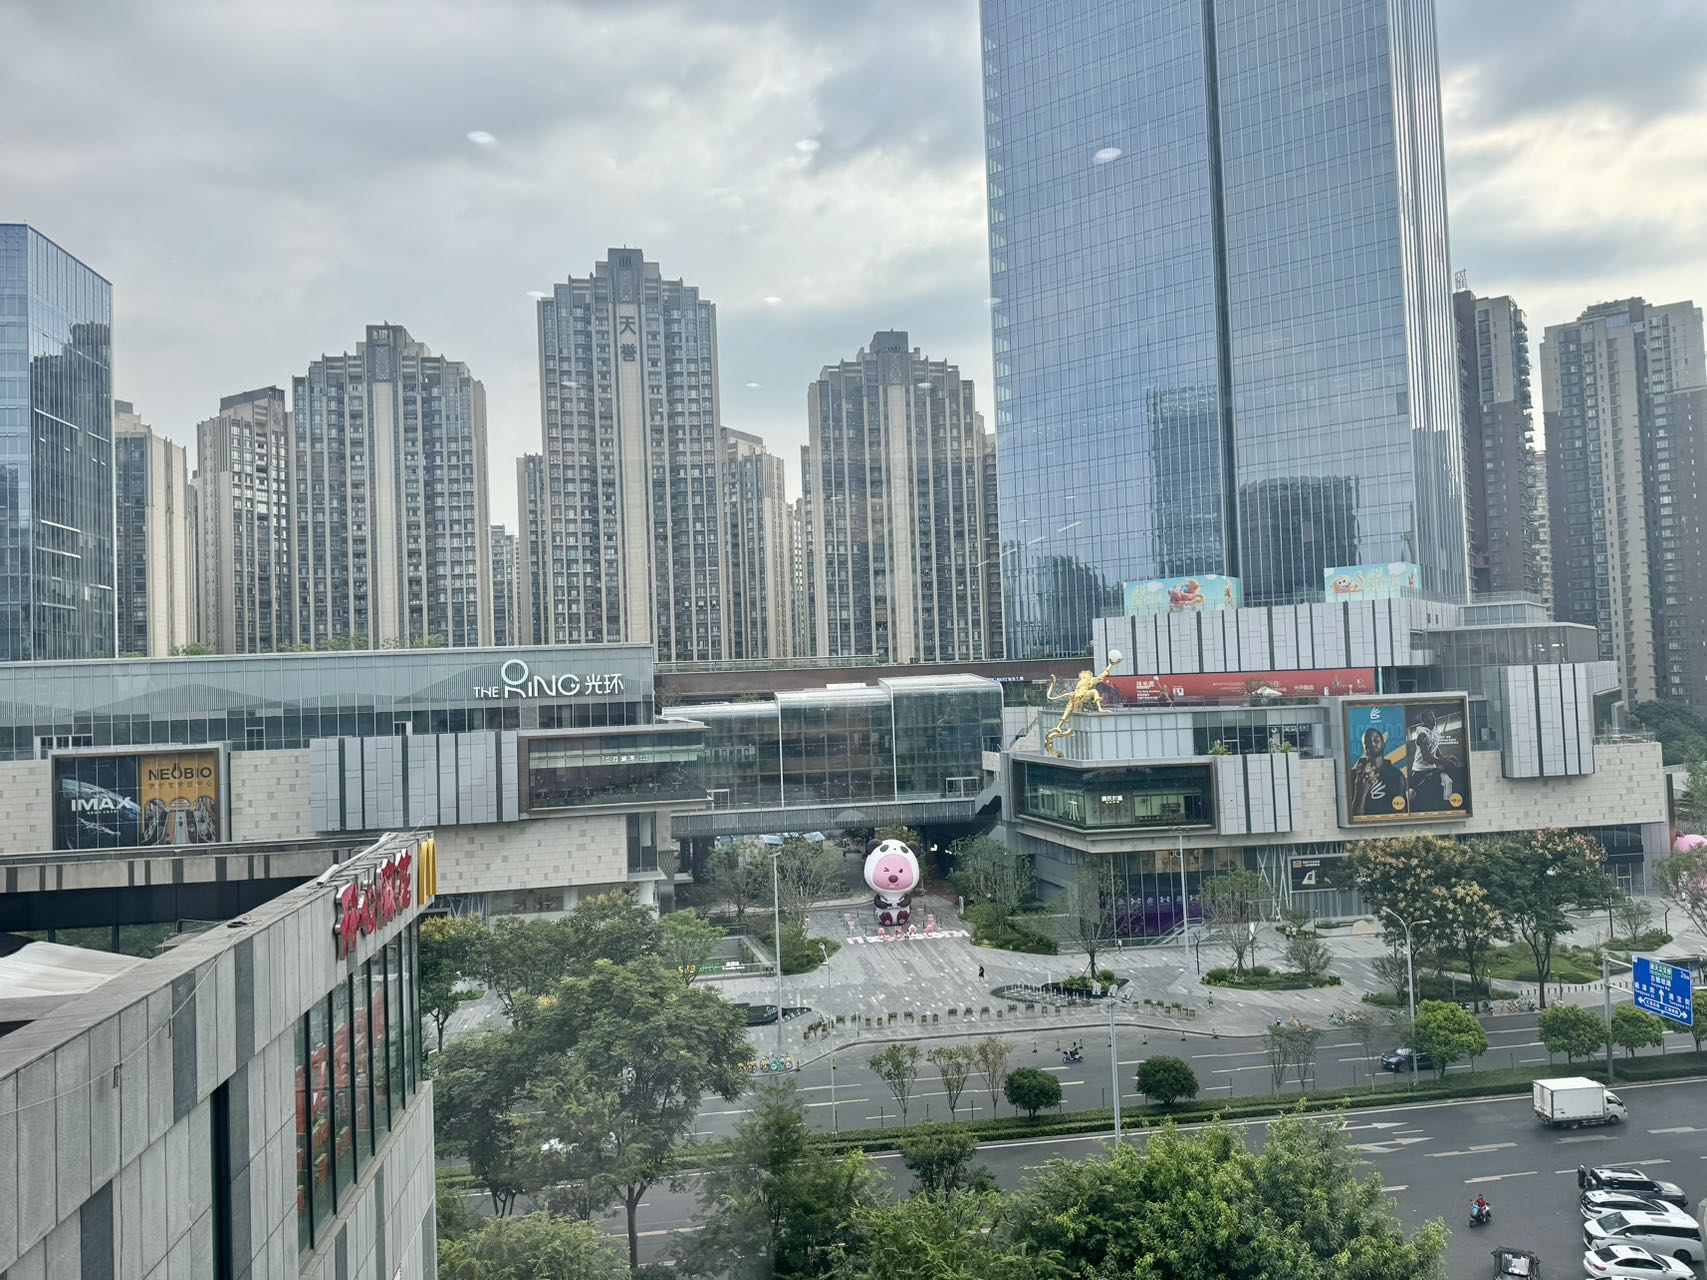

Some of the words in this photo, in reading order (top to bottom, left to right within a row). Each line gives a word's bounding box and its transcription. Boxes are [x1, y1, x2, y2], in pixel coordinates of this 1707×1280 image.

[619, 315, 638, 362] 天誉
[473, 686, 499, 699] THE
[501, 658, 581, 699] RING
[584, 673, 624, 695] 光环
[148, 763, 212, 781] NEOBIO
[71, 796, 132, 812] IMAX
